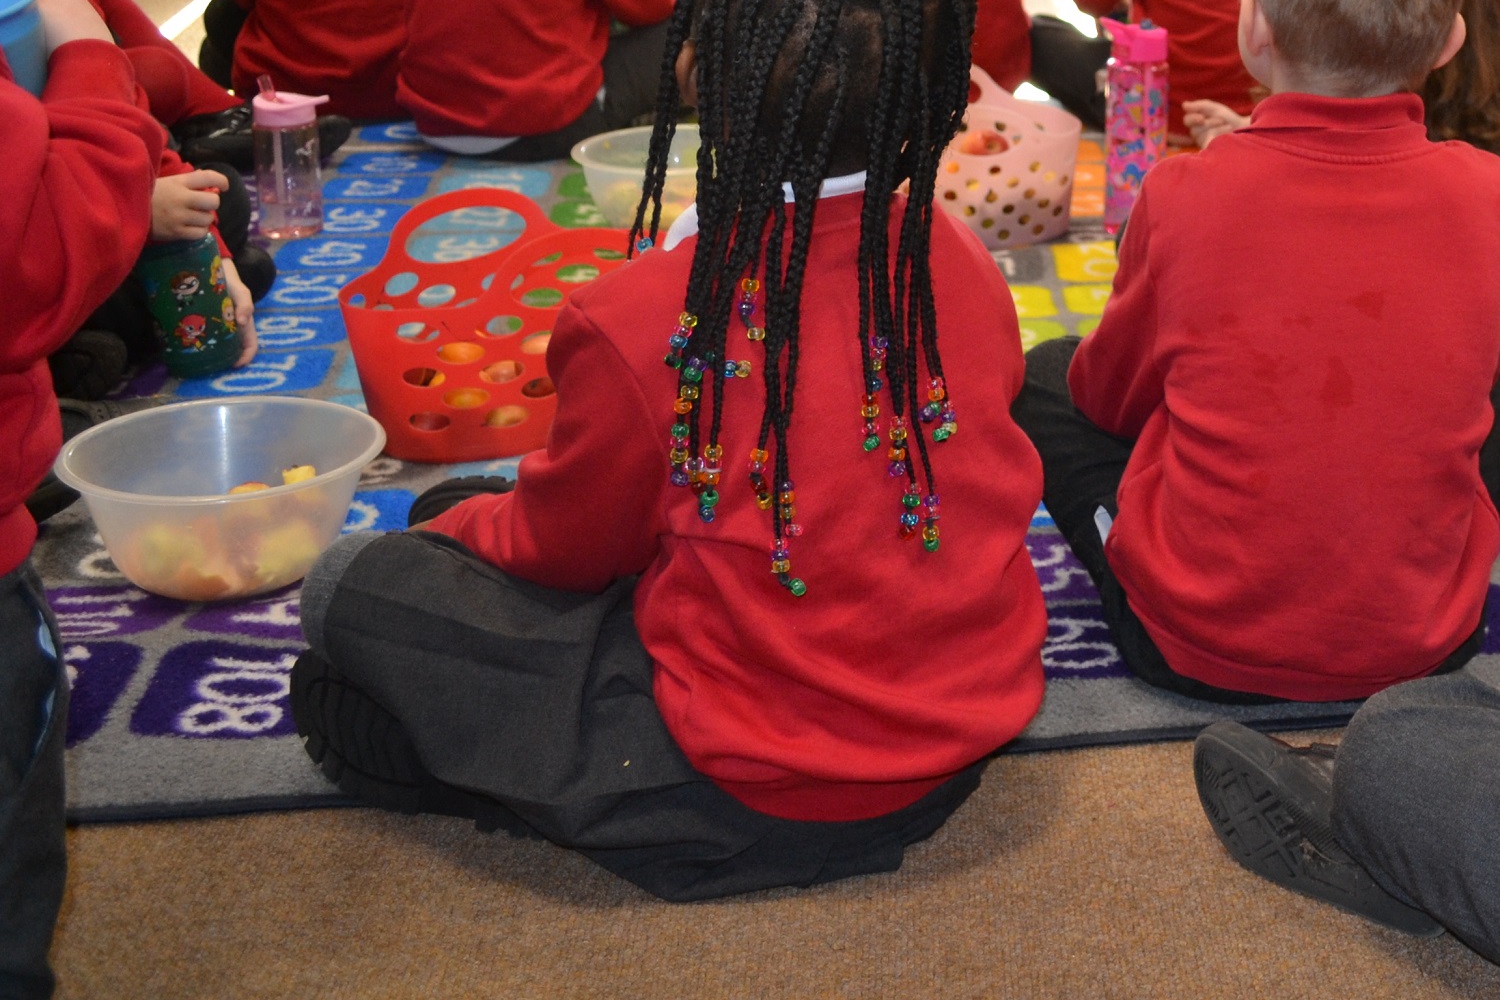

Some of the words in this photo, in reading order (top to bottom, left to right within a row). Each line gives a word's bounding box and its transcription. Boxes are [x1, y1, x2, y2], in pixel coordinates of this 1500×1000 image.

[323, 207, 387, 232] 30
[299, 241, 367, 267] 40
[272, 274, 348, 304] 50
[257, 315, 323, 347] 60
[211, 354, 298, 392] 70
[1041, 616, 1121, 669] 60
[178, 654, 299, 734] 108
